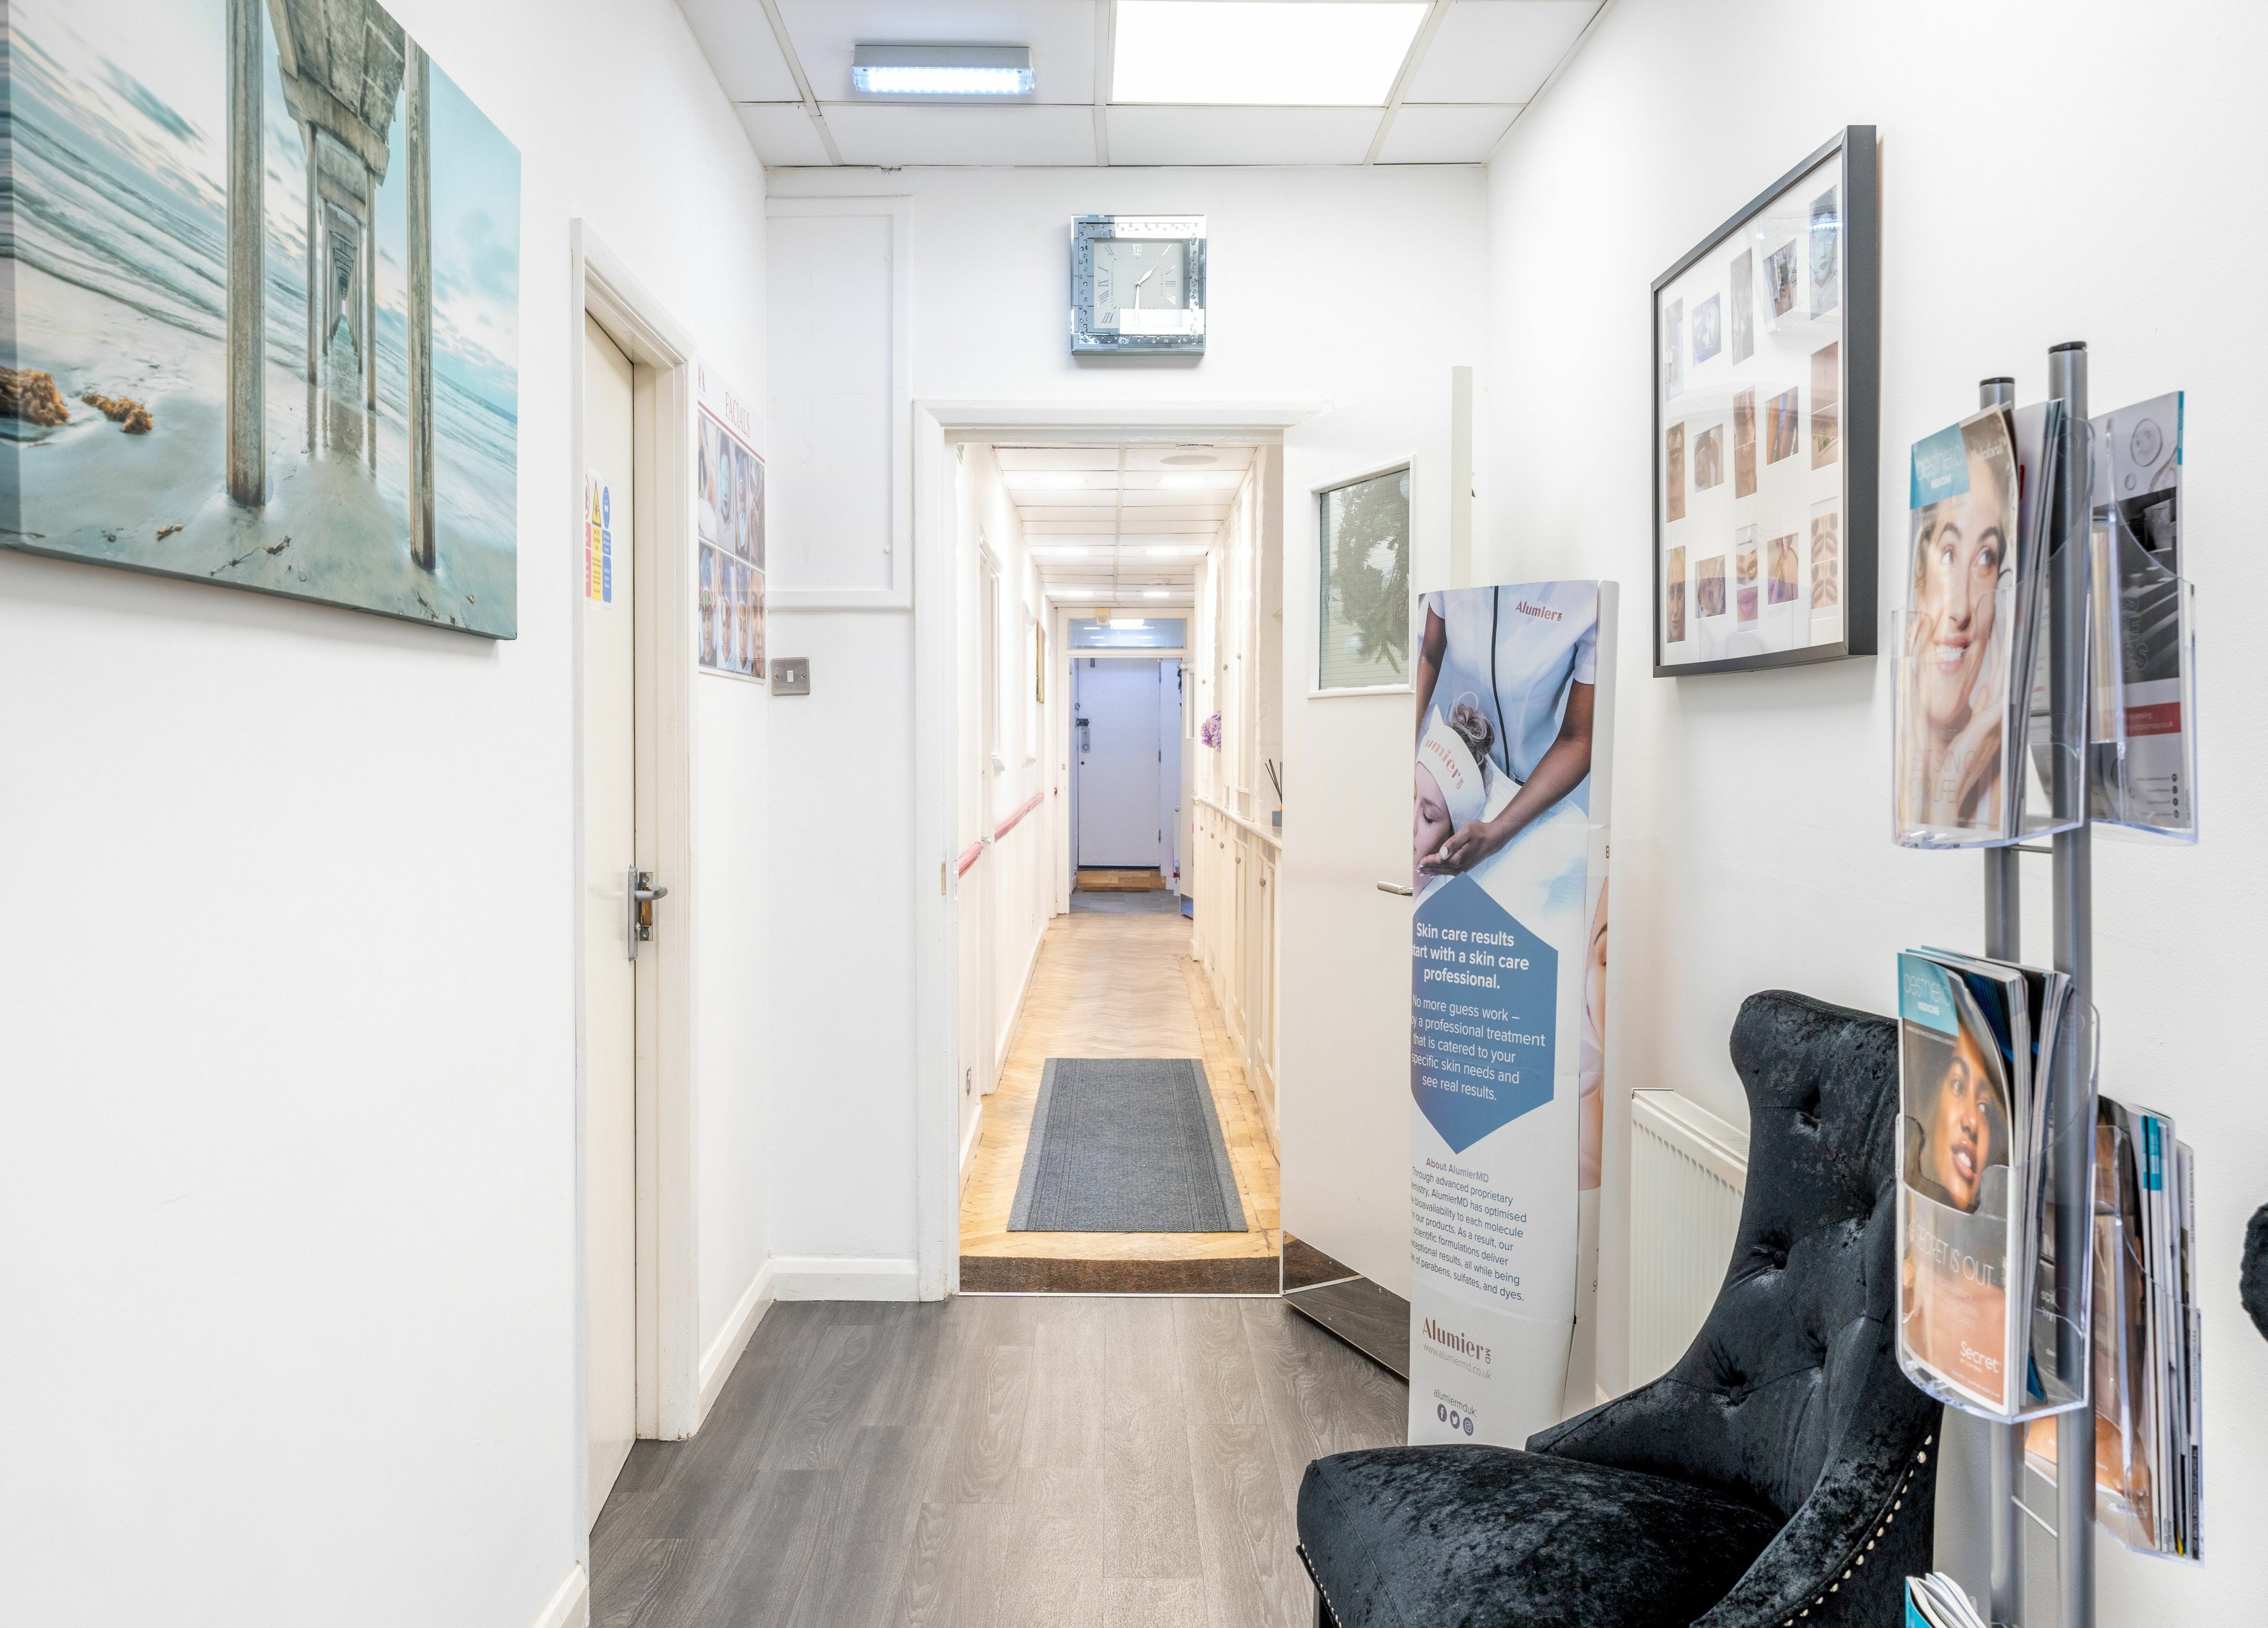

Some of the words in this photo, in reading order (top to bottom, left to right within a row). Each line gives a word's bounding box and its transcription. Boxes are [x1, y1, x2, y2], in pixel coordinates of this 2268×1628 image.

[725, 391, 750, 438] FACIALS
[1515, 600, 1557, 620] Alumier
[1417, 923, 1438, 939] Skin
[1442, 929, 1468, 942] care
[1471, 931, 1514, 946] results
[1430, 946, 1455, 961] with
[1459, 952, 1465, 963] a
[1469, 950, 1494, 966] skin
[1498, 957, 1529, 970] care
[1424, 968, 1500, 989] professional.
[1412, 994, 1421, 1007] No
[1423, 999, 1446, 1012] more
[1449, 1004, 1479, 1017] guess
[1482, 1008, 1508, 1021] work
[1413, 1033, 1426, 1047] that
[1428, 1036, 1435, 1049] is
[1438, 1040, 1475, 1056] catered
[1478, 1045, 1488, 1059] to
[1491, 1050, 1516, 1063] your
[1419, 1017, 1423, 1027] a
[1425, 1018, 1484, 1038] professional
[1487, 1027, 1546, 1047] treatment
[1412, 1052, 1439, 1069] specific
[1441, 1059, 1461, 1073] skin
[1464, 1064, 1495, 1080] needs
[1498, 1071, 1519, 1084] and
[1422, 1075, 1438, 1087] see
[1441, 1080, 1458, 1092] real
[1461, 1085, 1497, 1100] results.
[1412, 1166, 1434, 1184] Through
[1436, 1176, 1469, 1193] advanced
[1471, 1186, 1513, 1207] proprietary
[1426, 1158, 1447, 1171] About
[1448, 1164, 1489, 1183] AlumierMD
[1411, 1181, 1430, 1197] emistry,
[1431, 1189, 1468, 1207] AlumierMD
[1470, 1200, 1482, 1212] has
[1484, 1207, 1527, 1223] optimised
[1415, 1197, 1455, 1221] bioavailability
[1457, 1212, 1464, 1222] to
[1465, 1215, 1482, 1228] each
[1484, 1221, 1523, 1238] molecule
[1413, 1226, 1437, 1243] scientific
[1439, 1235, 1480, 1258] formulations
[1481, 1251, 1508, 1266] deliver
[1416, 1213, 1424, 1223] our
[1426, 1216, 1456, 1234] products.
[1458, 1226, 1467, 1238] As
[1474, 1233, 1497, 1248] result,
[1498, 1241, 1514, 1252] our
[1415, 1256, 1420, 1265] of
[1421, 1259, 1452, 1279] parabens,
[1454, 1272, 1481, 1290] sulfates,
[1483, 1282, 1497, 1294] and
[1500, 1288, 1524, 1301] dyes.
[1439, 1251, 1462, 1268] results,
[1474, 1264, 1493, 1277] while
[1495, 1269, 1520, 1287] being
[1950, 1248, 1960, 1273] IS
[1963, 1255, 1995, 1289] OUT
[1422, 1317, 1484, 1360] Alumier
[1485, 1348, 1491, 1364] MD
[1960, 1340, 2001, 1373] Secret
[1423, 1343, 1492, 1380] www.alumiermd.co.uk
[1433, 1389, 1477, 1418] alumiermduk:
